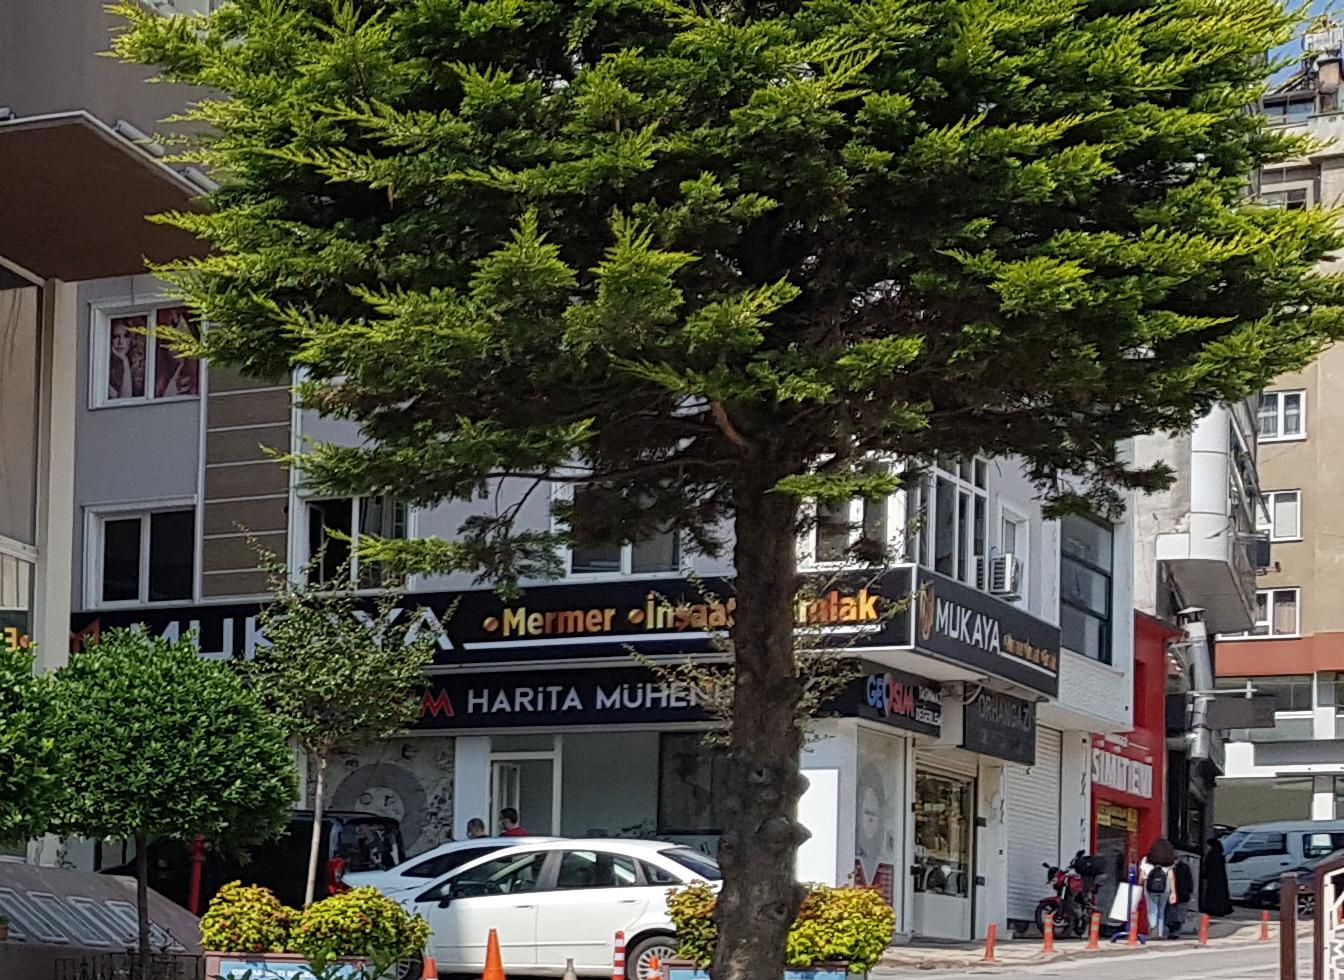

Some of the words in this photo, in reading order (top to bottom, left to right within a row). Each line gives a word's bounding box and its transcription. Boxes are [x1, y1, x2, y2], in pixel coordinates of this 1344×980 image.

[503, 607, 616, 636] Mermer
[795, 588, 879, 623] mlak
[936, 597, 1001, 655] MUKAYA
